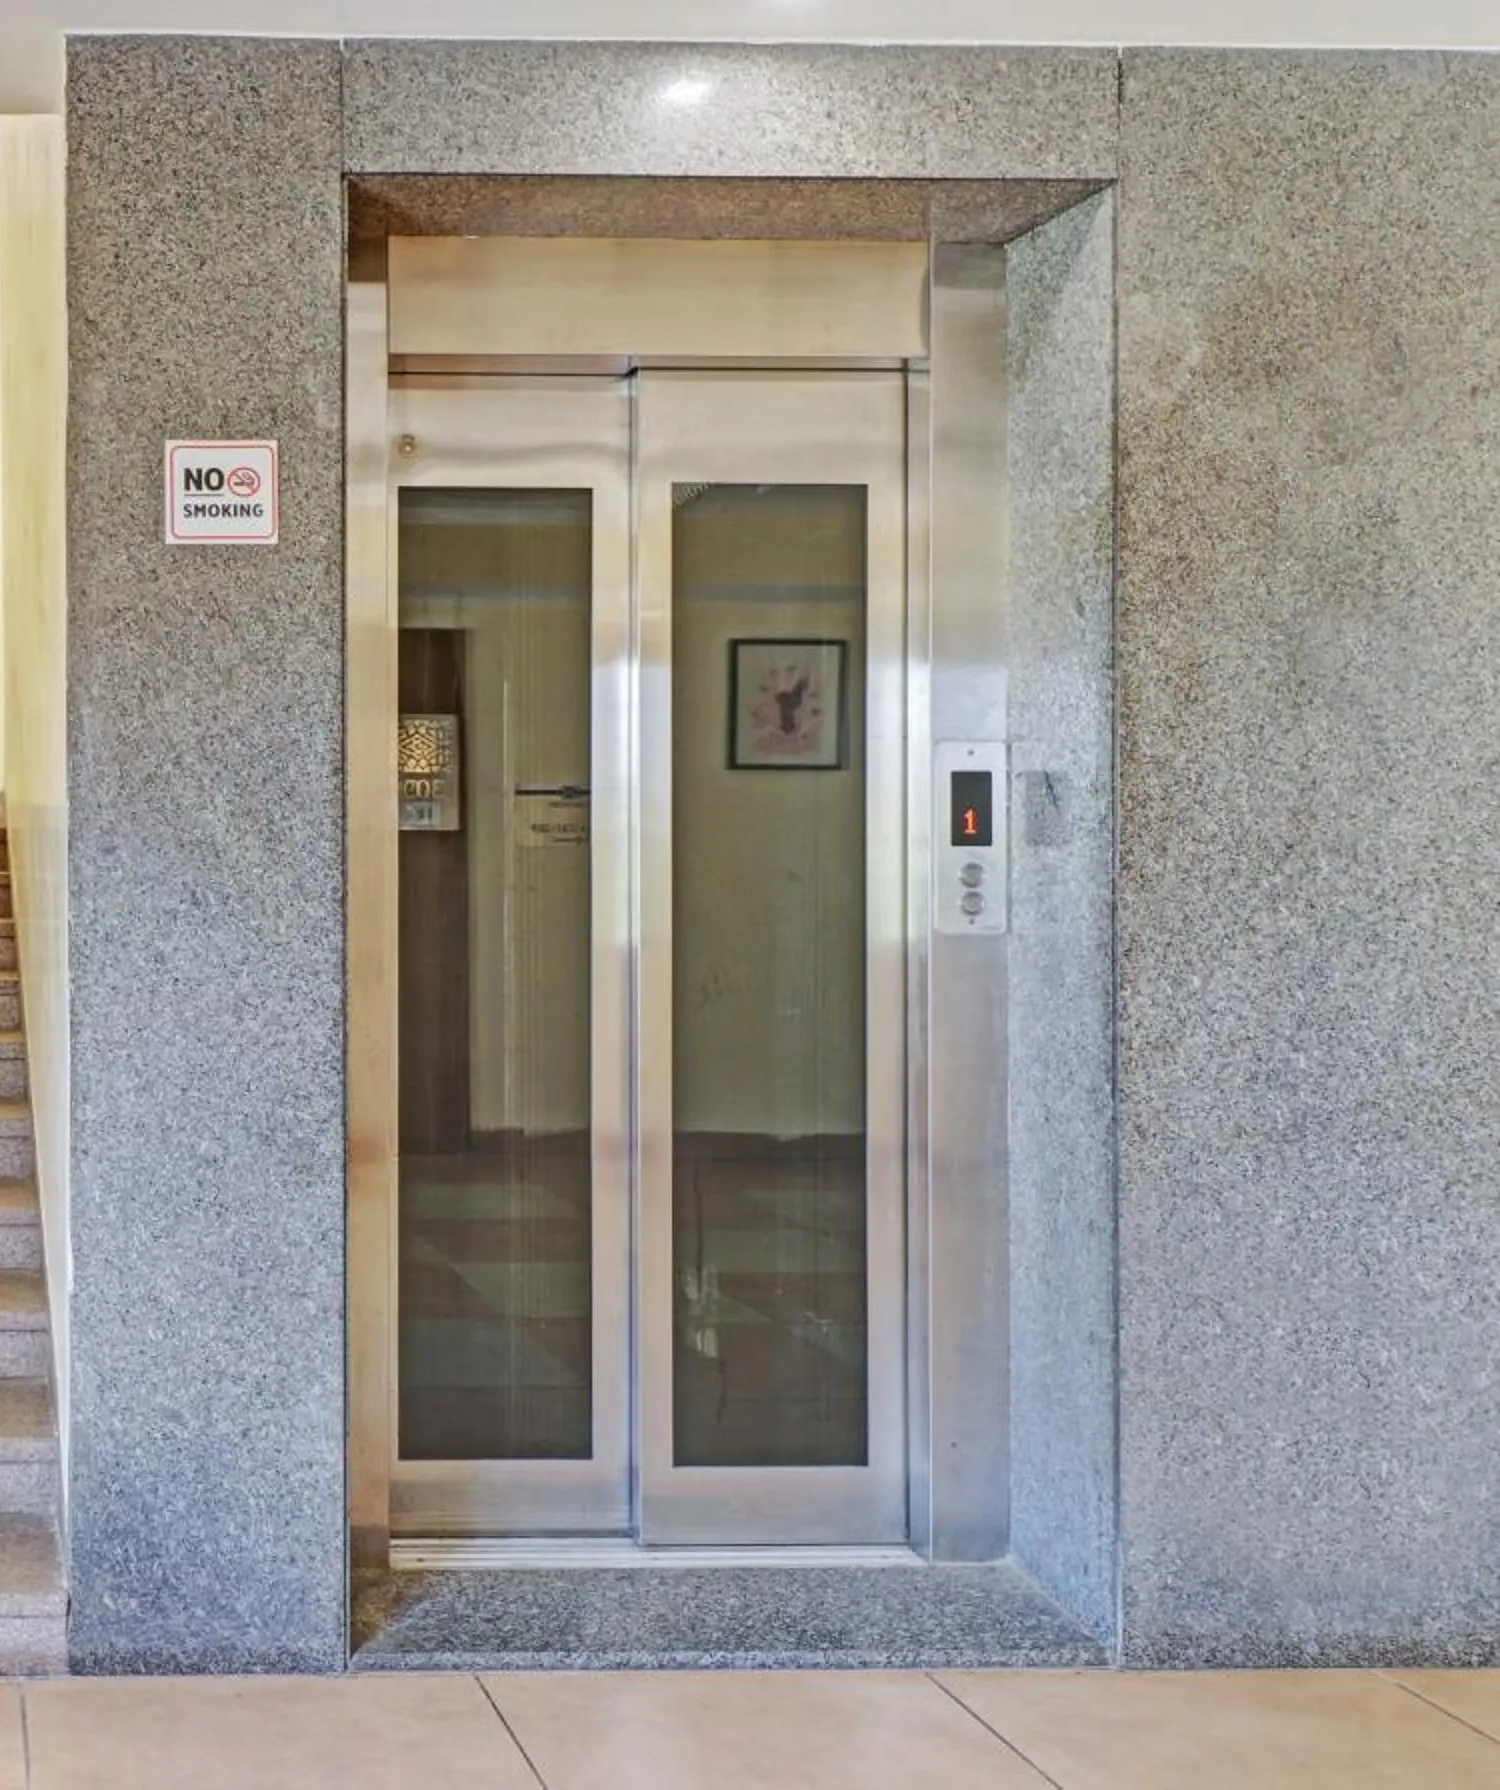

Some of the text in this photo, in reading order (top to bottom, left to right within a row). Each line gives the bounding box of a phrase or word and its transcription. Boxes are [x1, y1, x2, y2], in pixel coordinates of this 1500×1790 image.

[183, 467, 225, 491] NO
[183, 503, 264, 518] SMOKING
[963, 806, 978, 834] 1
